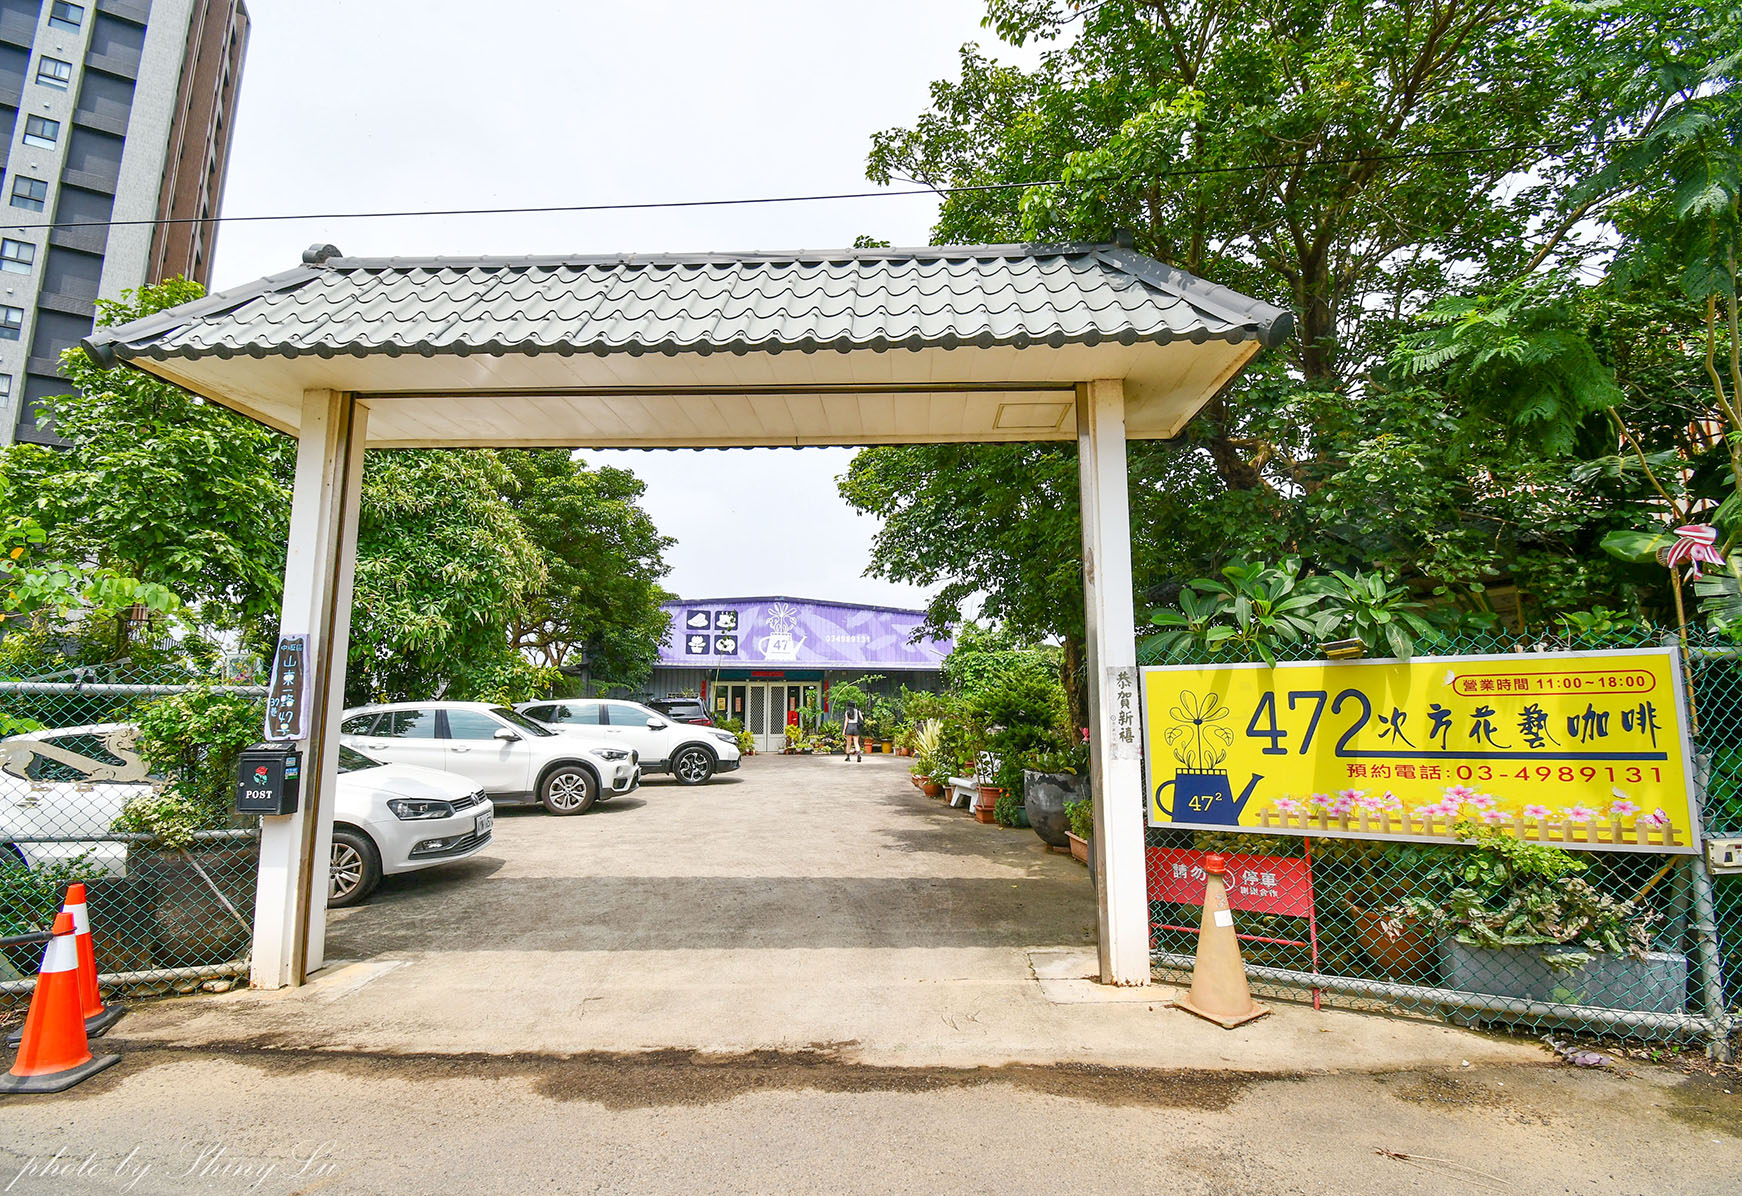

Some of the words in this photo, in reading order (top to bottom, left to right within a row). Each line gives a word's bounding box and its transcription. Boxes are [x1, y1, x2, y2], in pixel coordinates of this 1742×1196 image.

[1463, 678, 1529, 692] 營業時間
[1536, 675, 1646, 690] 11:00~18:00
[1116, 671, 1135, 744] 恭賀新禧
[245, 790, 273, 799] POST
[1172, 863, 1207, 882] 請勿
[1242, 869, 1278, 888] 停車
